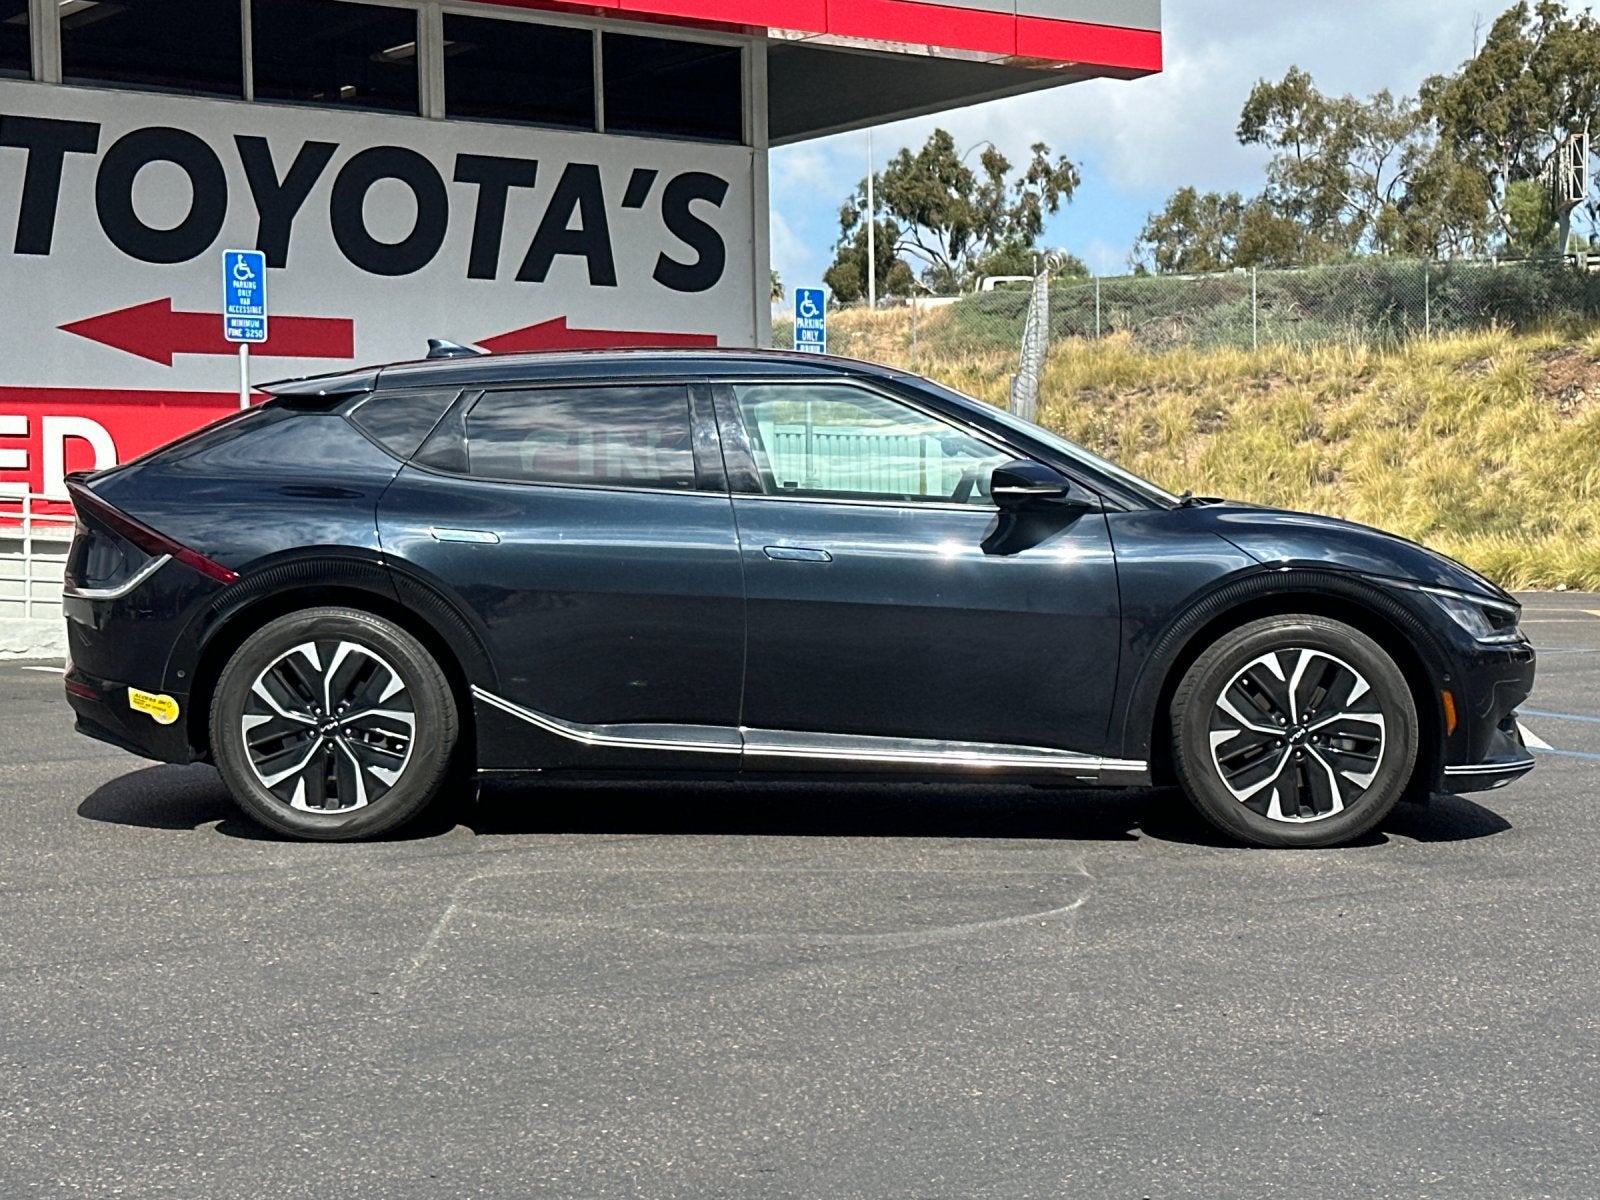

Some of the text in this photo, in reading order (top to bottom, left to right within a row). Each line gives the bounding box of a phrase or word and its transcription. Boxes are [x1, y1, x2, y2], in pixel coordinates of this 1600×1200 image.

[0, 114, 730, 292] TOYOTA'S
[233, 280, 256, 289] PARKING
[237, 289, 252, 297] ONLY
[239, 297, 251, 305] VAN
[228, 305, 262, 314] ACCESSIBLE
[231, 319, 260, 328] MINIMUM
[797, 318, 823, 330] PARKING
[802, 329, 819, 341] ONLY
